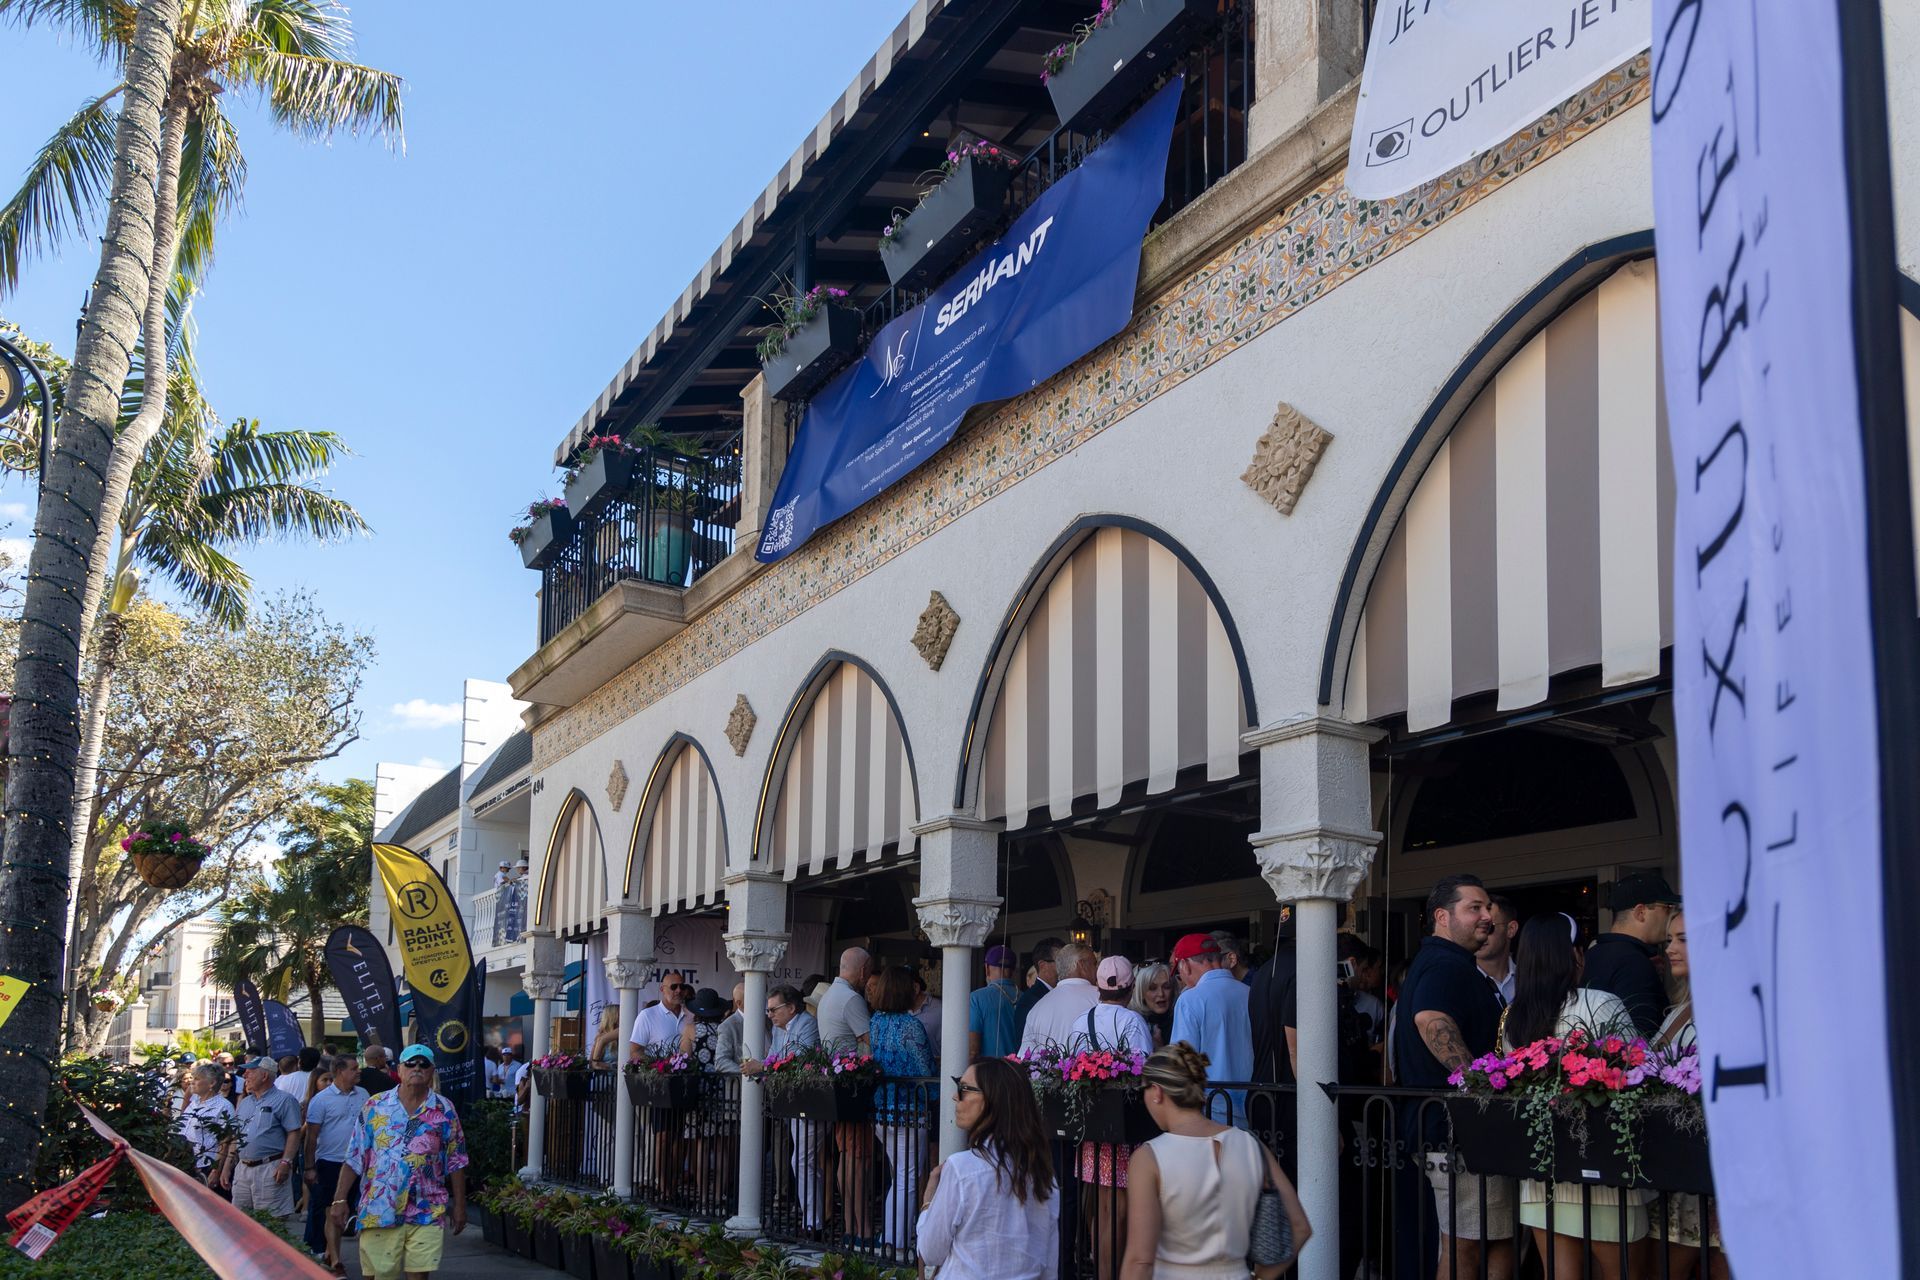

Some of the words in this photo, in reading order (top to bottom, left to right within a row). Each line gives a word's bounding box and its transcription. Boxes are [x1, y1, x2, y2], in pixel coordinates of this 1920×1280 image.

[1421, 26, 1556, 138] OUTLIER
[934, 215, 1054, 336] SERHANT
[939, 334, 977, 365] SPONSORED
[977, 323, 987, 336] BY
[947, 384, 965, 402] Outlier
[1696, 60, 1769, 1102] LUXURE
[403, 920, 452, 938] RALLY
[405, 929, 454, 947] POINT
[407, 938, 457, 953] GARAGE
[412, 949, 450, 962] AUTOMOTIVE
[411, 956, 442, 967] LIFESTYLE
[442, 952, 460, 961] CLUB
[352, 960, 385, 1015] ELITE
[244, 999, 260, 1033] ELITE
[352, 998, 369, 1020] jets
